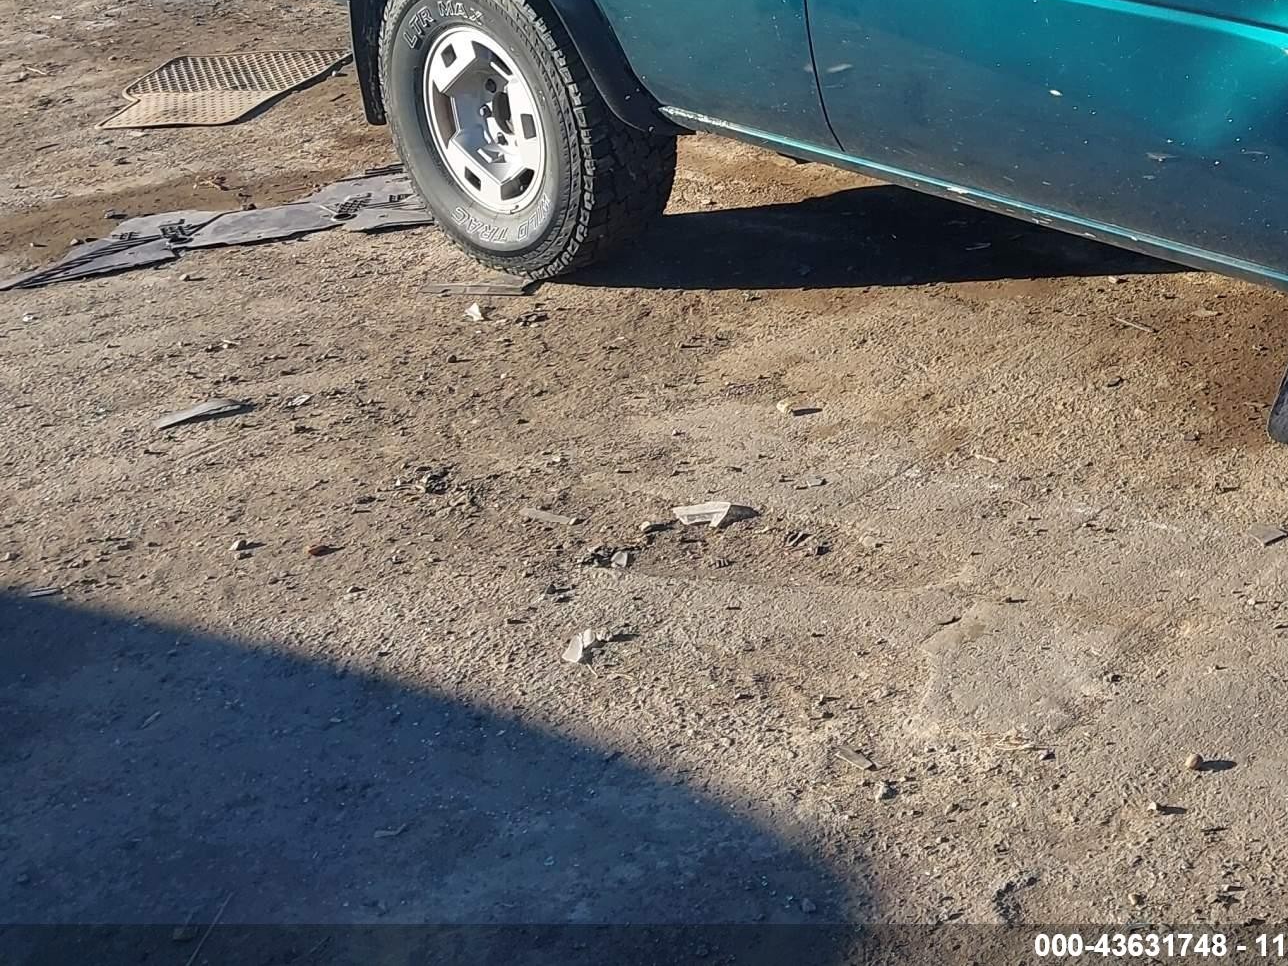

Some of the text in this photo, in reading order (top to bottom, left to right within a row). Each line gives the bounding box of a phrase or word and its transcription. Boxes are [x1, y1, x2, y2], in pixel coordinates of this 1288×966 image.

[403, 5, 435, 49] LTR
[451, 192, 552, 244] WILD TRAC
